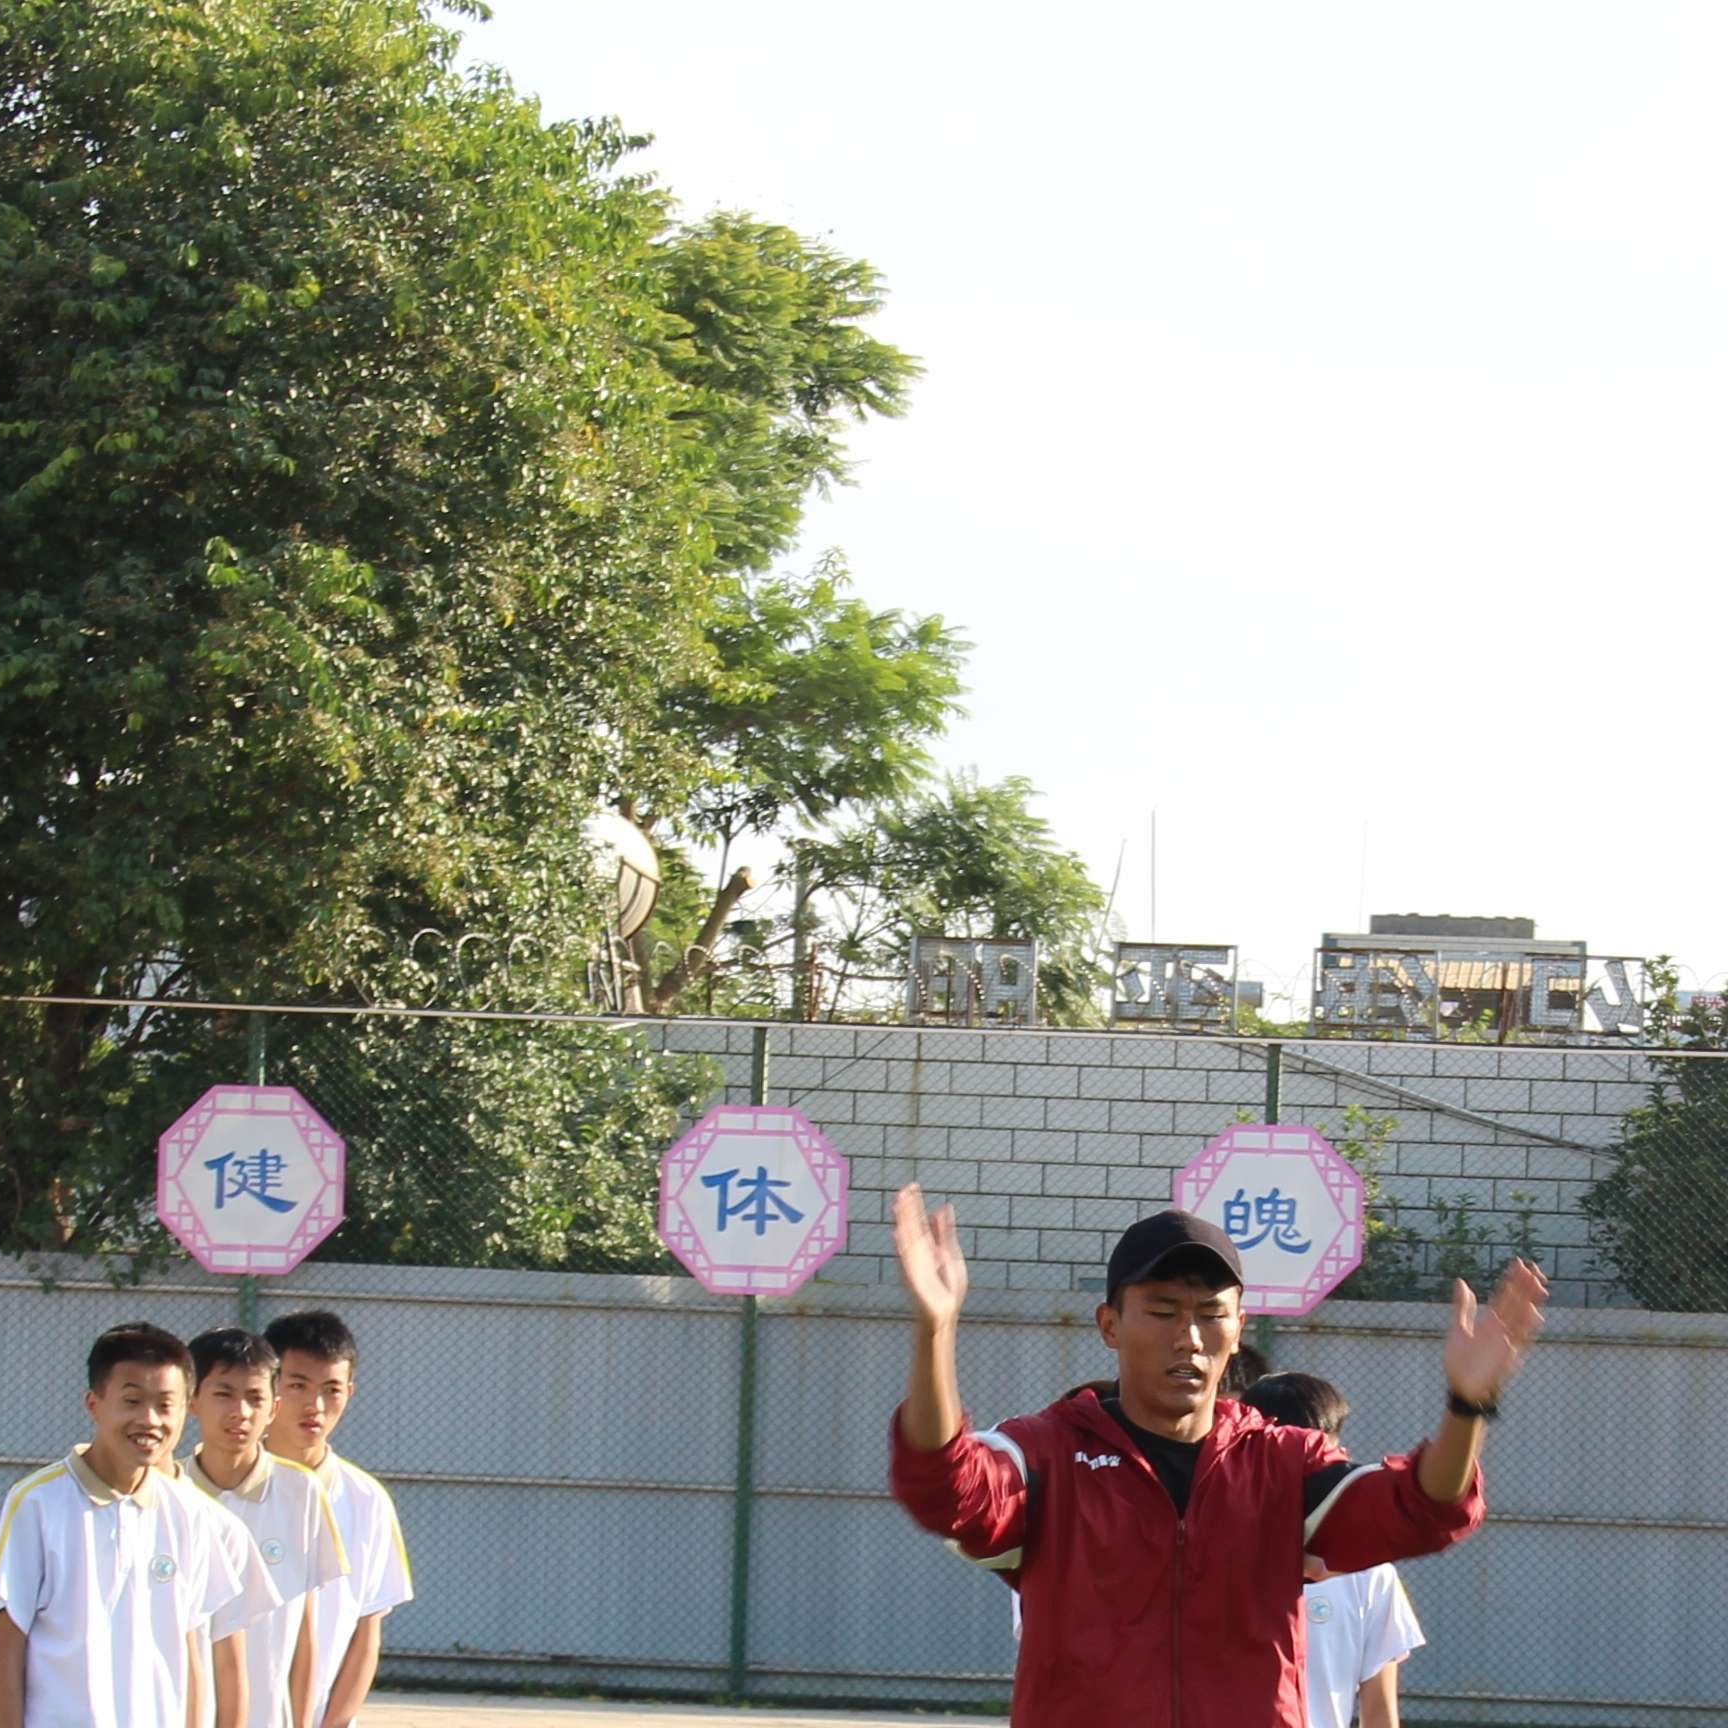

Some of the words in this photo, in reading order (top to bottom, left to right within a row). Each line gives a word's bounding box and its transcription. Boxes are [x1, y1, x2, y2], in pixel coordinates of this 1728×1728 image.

[204, 1148, 297, 1213] 健
[700, 1166, 804, 1236] 体
[1223, 1187, 1312, 1255] 魄
